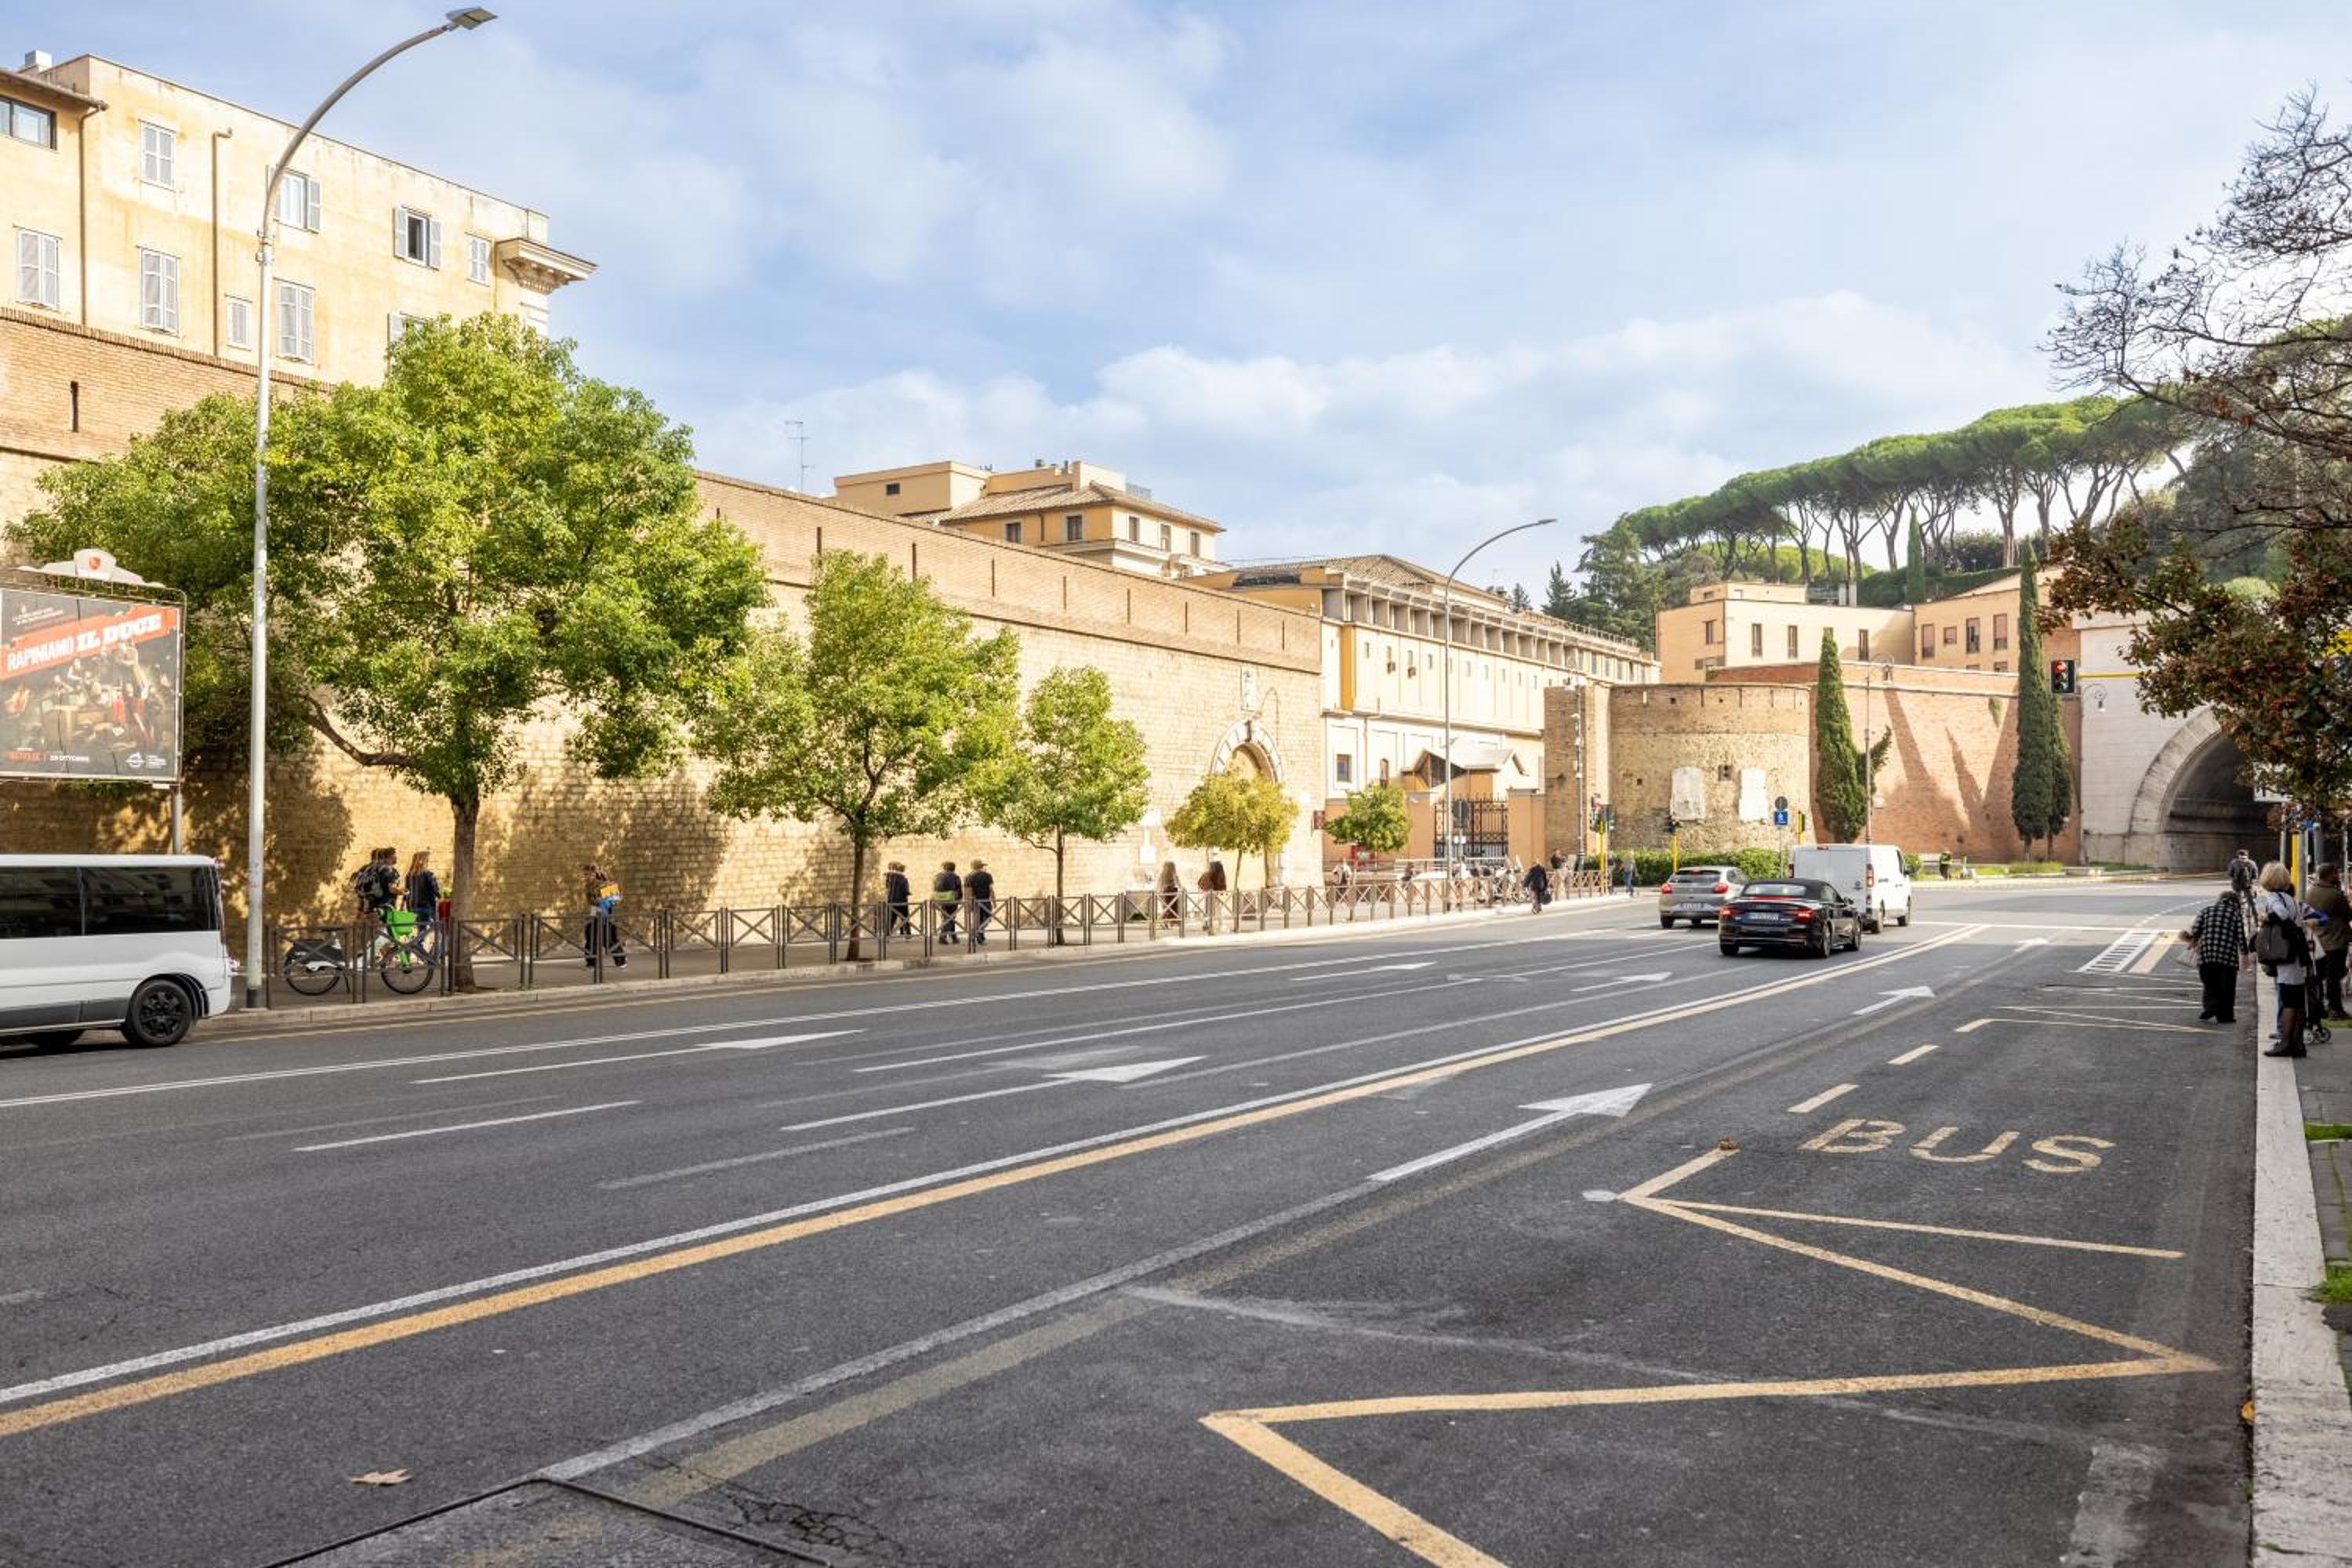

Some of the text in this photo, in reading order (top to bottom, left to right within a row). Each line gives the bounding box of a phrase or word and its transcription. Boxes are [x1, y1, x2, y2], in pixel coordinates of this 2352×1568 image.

[7, 637, 74, 672] RAPINIAMO
[75, 630, 101, 652] IL
[1797, 1119, 2116, 1174] BUS
